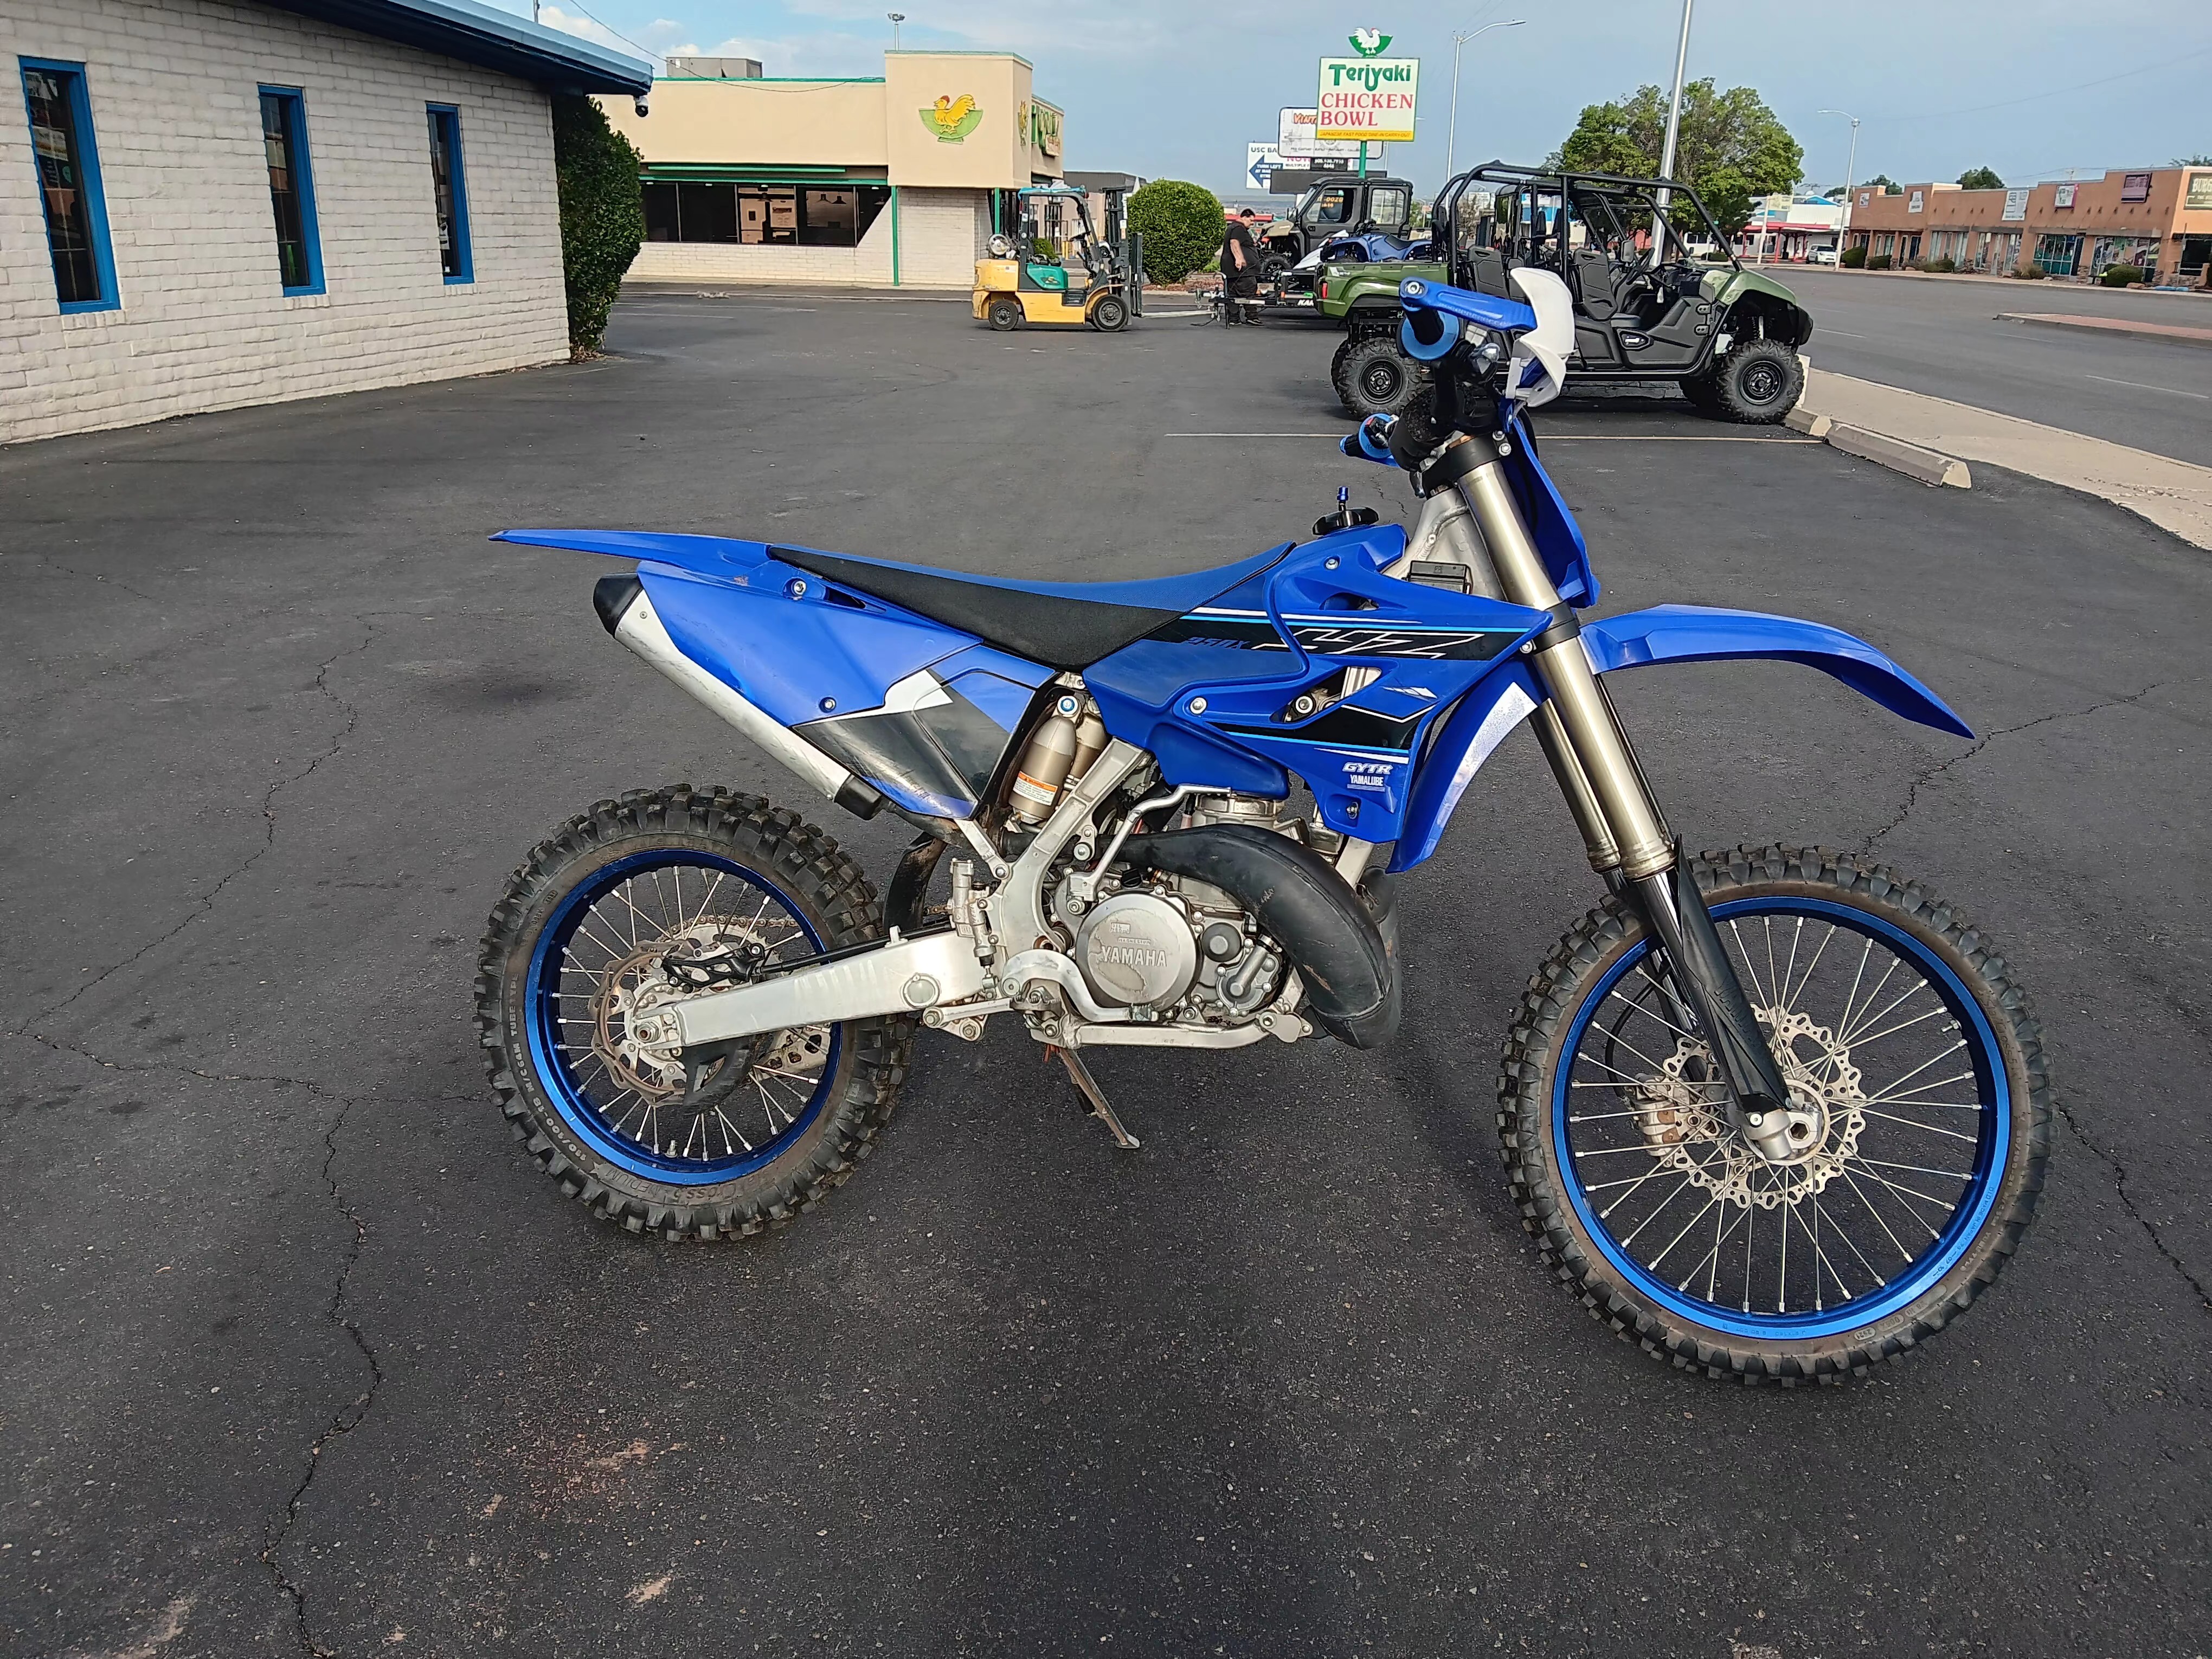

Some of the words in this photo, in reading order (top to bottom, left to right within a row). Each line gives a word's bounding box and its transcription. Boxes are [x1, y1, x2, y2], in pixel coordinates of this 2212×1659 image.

[1328, 64, 1411, 91] Teriyaki
[1321, 93, 1413, 108] CHICKEN
[1294, 113, 1317, 124] VINT
[1320, 111, 1378, 126] BOWL
[1342, 762, 1393, 775] GYTR
[1350, 774, 1384, 786] YAMALUBE
[1101, 946, 1167, 967] YAMAHA
[509, 1006, 519, 1037] TUBE
[605, 1168, 660, 1197] MEDIUM
